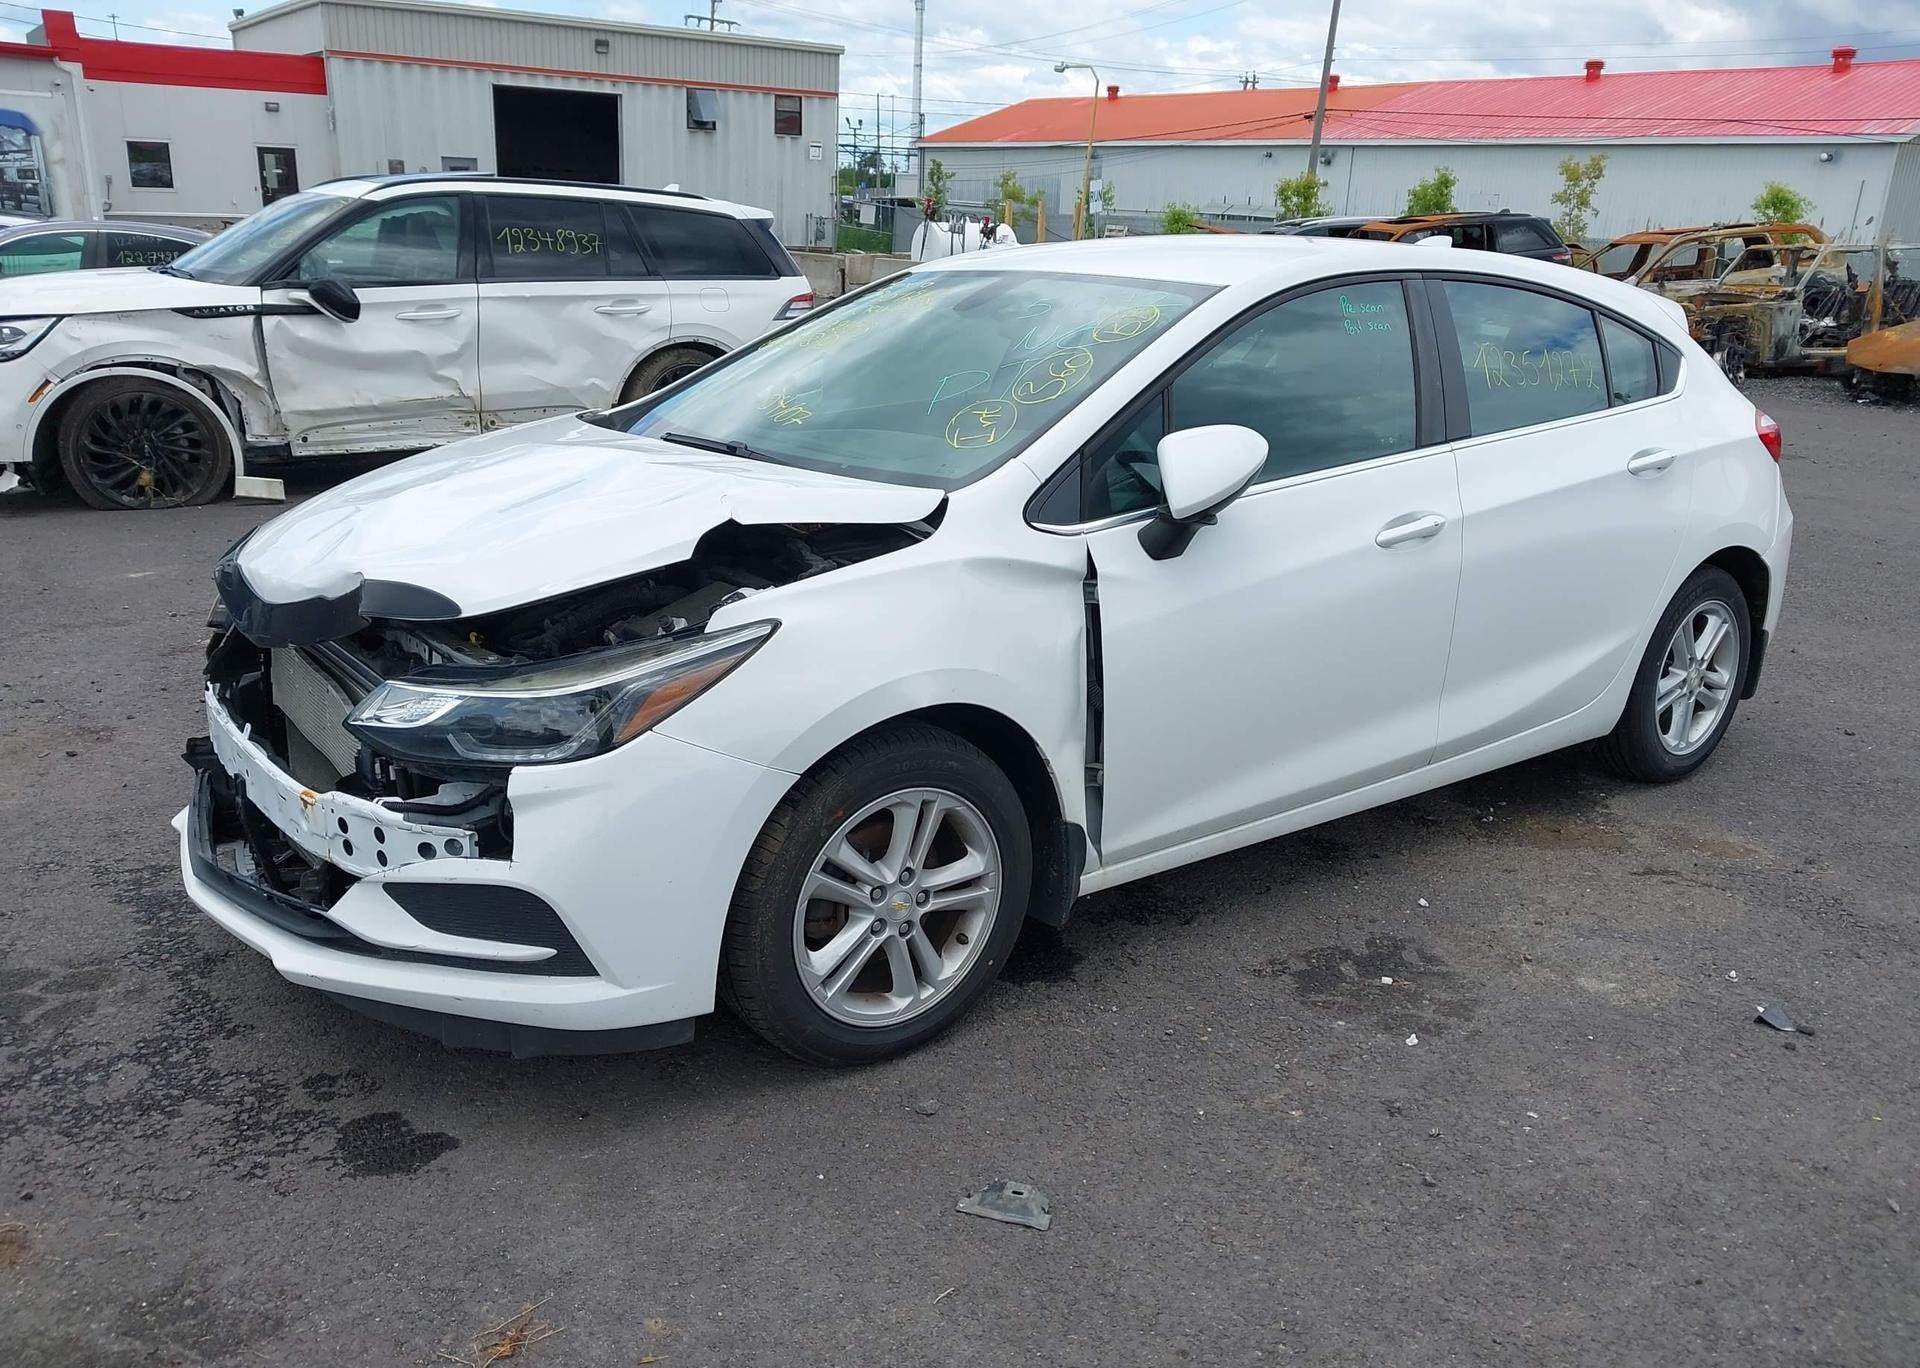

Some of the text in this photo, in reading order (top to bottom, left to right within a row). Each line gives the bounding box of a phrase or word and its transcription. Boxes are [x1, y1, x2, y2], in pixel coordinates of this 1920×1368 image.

[496, 227, 604, 254] 12348937
[193, 304, 255, 314] AVIATOR
[1339, 295, 1385, 317] Pre scan
